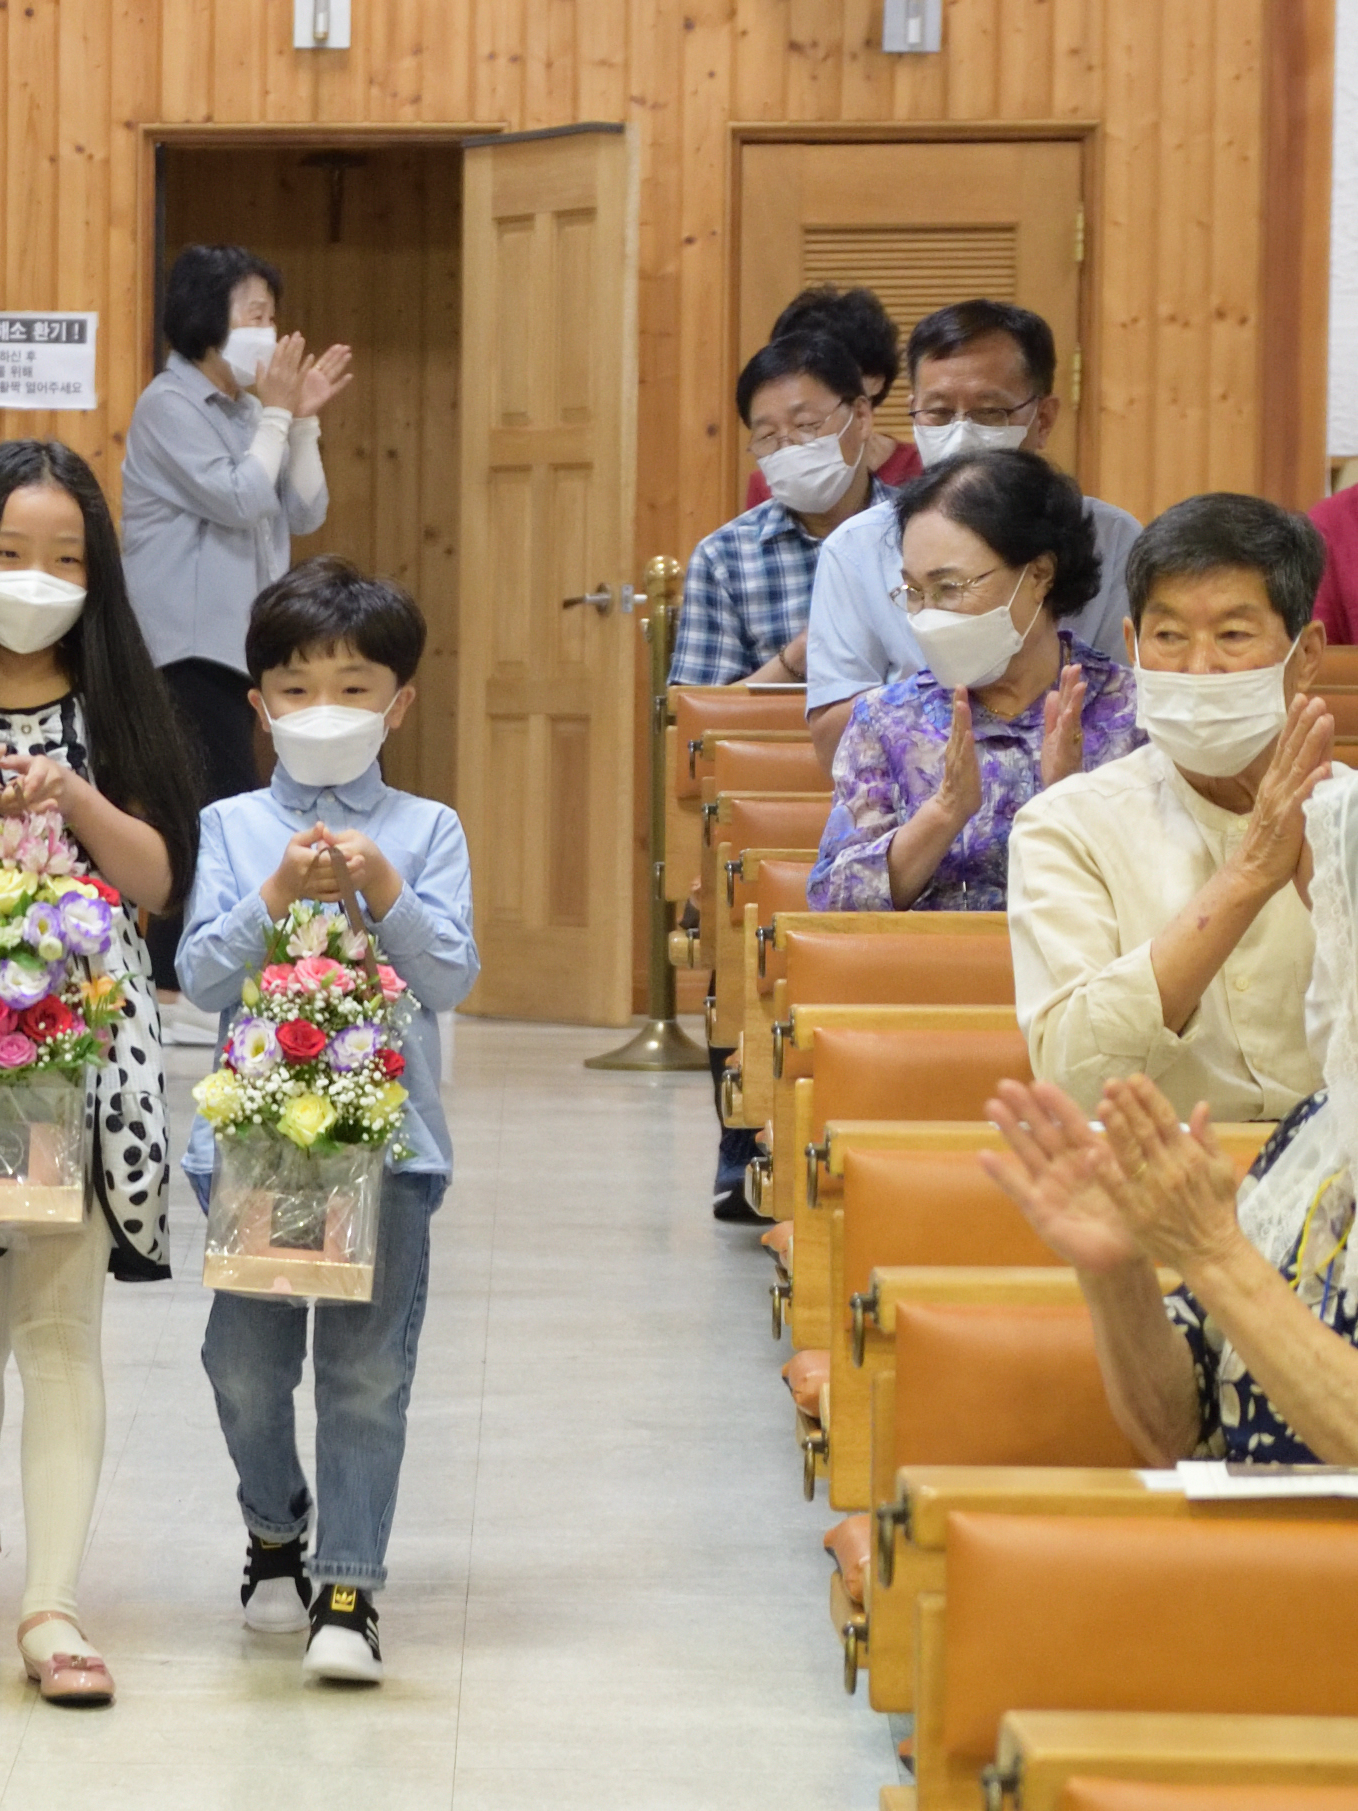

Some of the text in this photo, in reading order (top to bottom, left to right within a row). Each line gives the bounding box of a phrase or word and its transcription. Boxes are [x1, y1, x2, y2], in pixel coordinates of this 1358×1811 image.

[33, 321, 67, 342] 환기
[0, 349, 21, 362] 하신
[26, 350, 36, 362] 후
[10, 365, 33, 378] 위해
[0, 380, 21, 393] 활짝
[26, 381, 82, 394] 열어주세요
